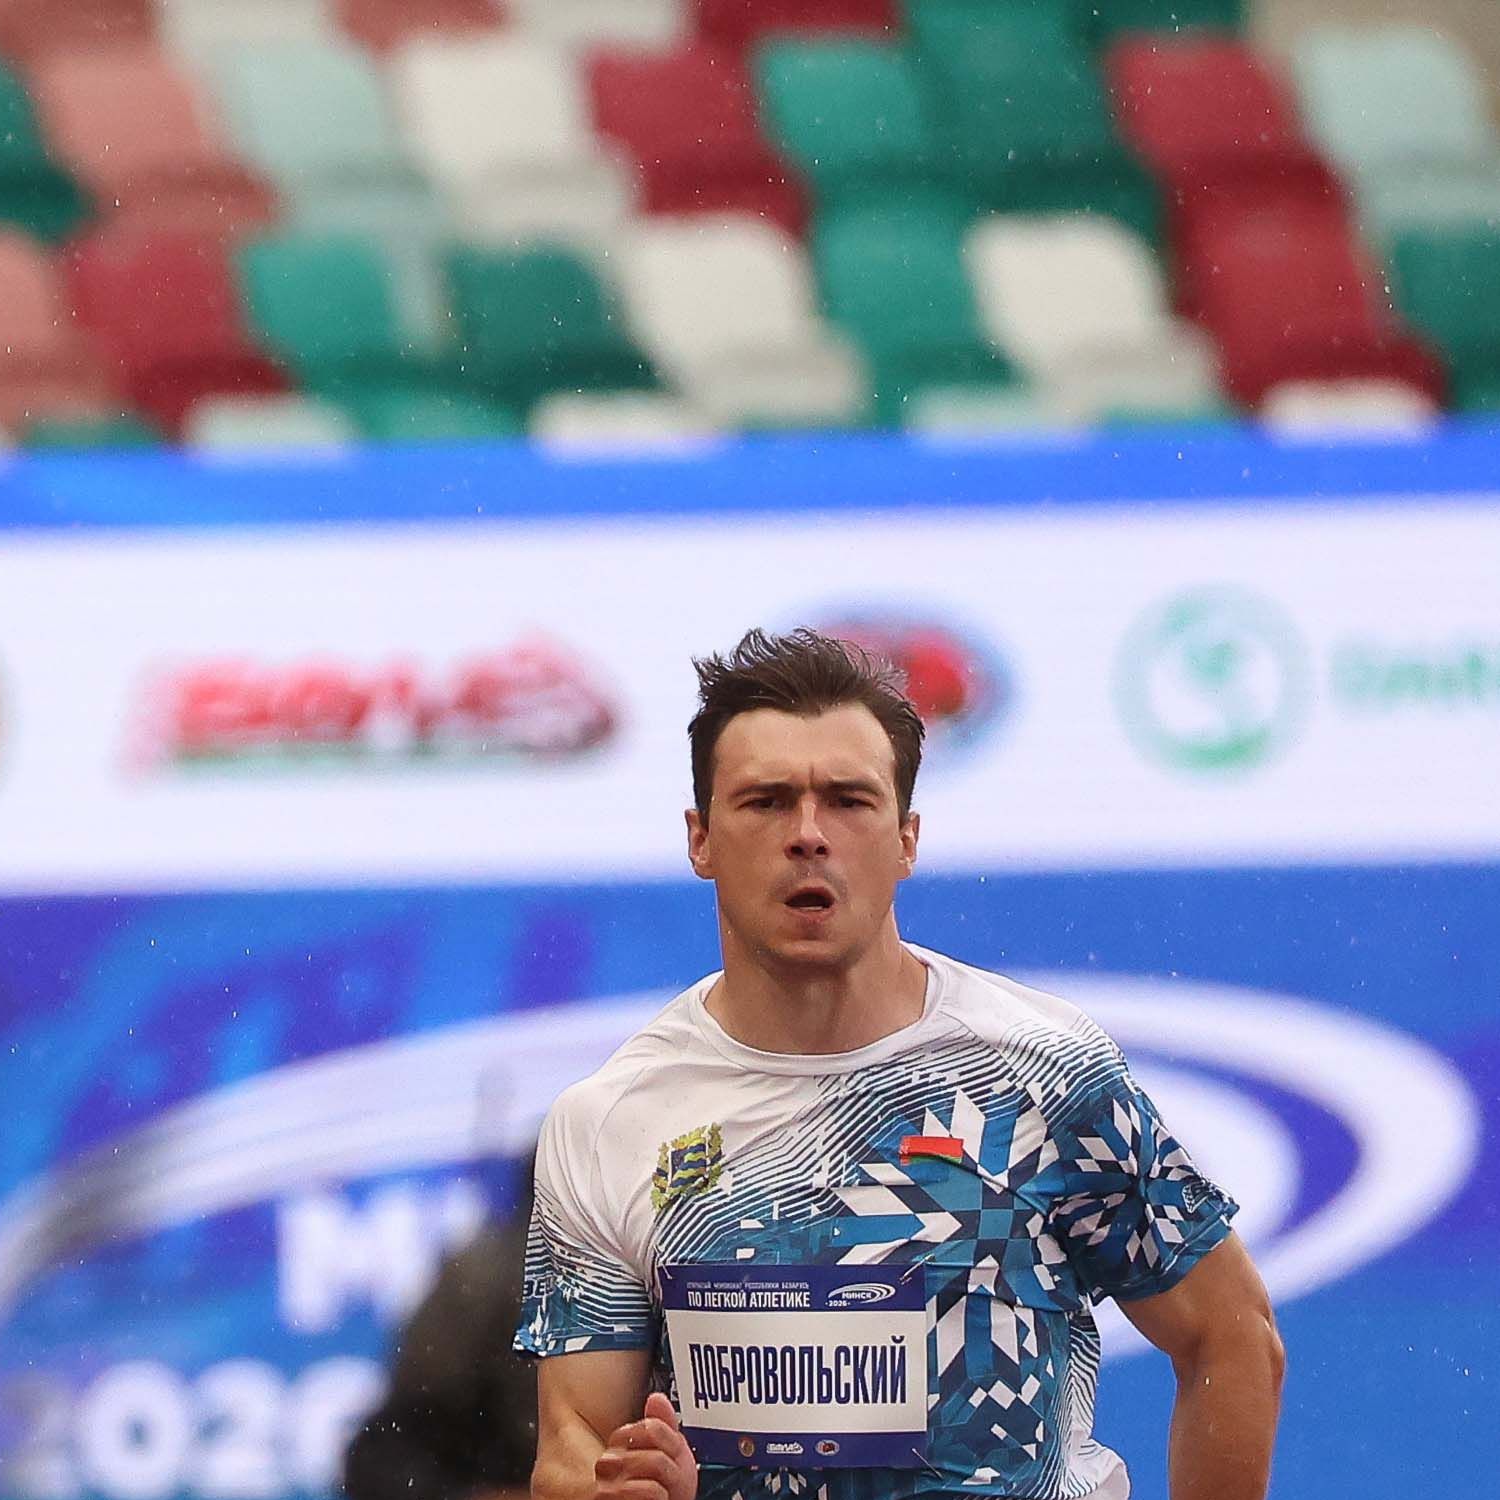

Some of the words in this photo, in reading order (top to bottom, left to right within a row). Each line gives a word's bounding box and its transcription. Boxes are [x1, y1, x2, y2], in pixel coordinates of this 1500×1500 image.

[687, 1291, 702, 1307] ПО
[704, 1289, 747, 1308] ЛЕГКОЙ
[749, 1291, 810, 1308] АТЛЕТИКЕ
[841, 1291, 872, 1300] МИНСК
[688, 1335, 907, 1409] ДОБРОВОЛЬСКИЙ
